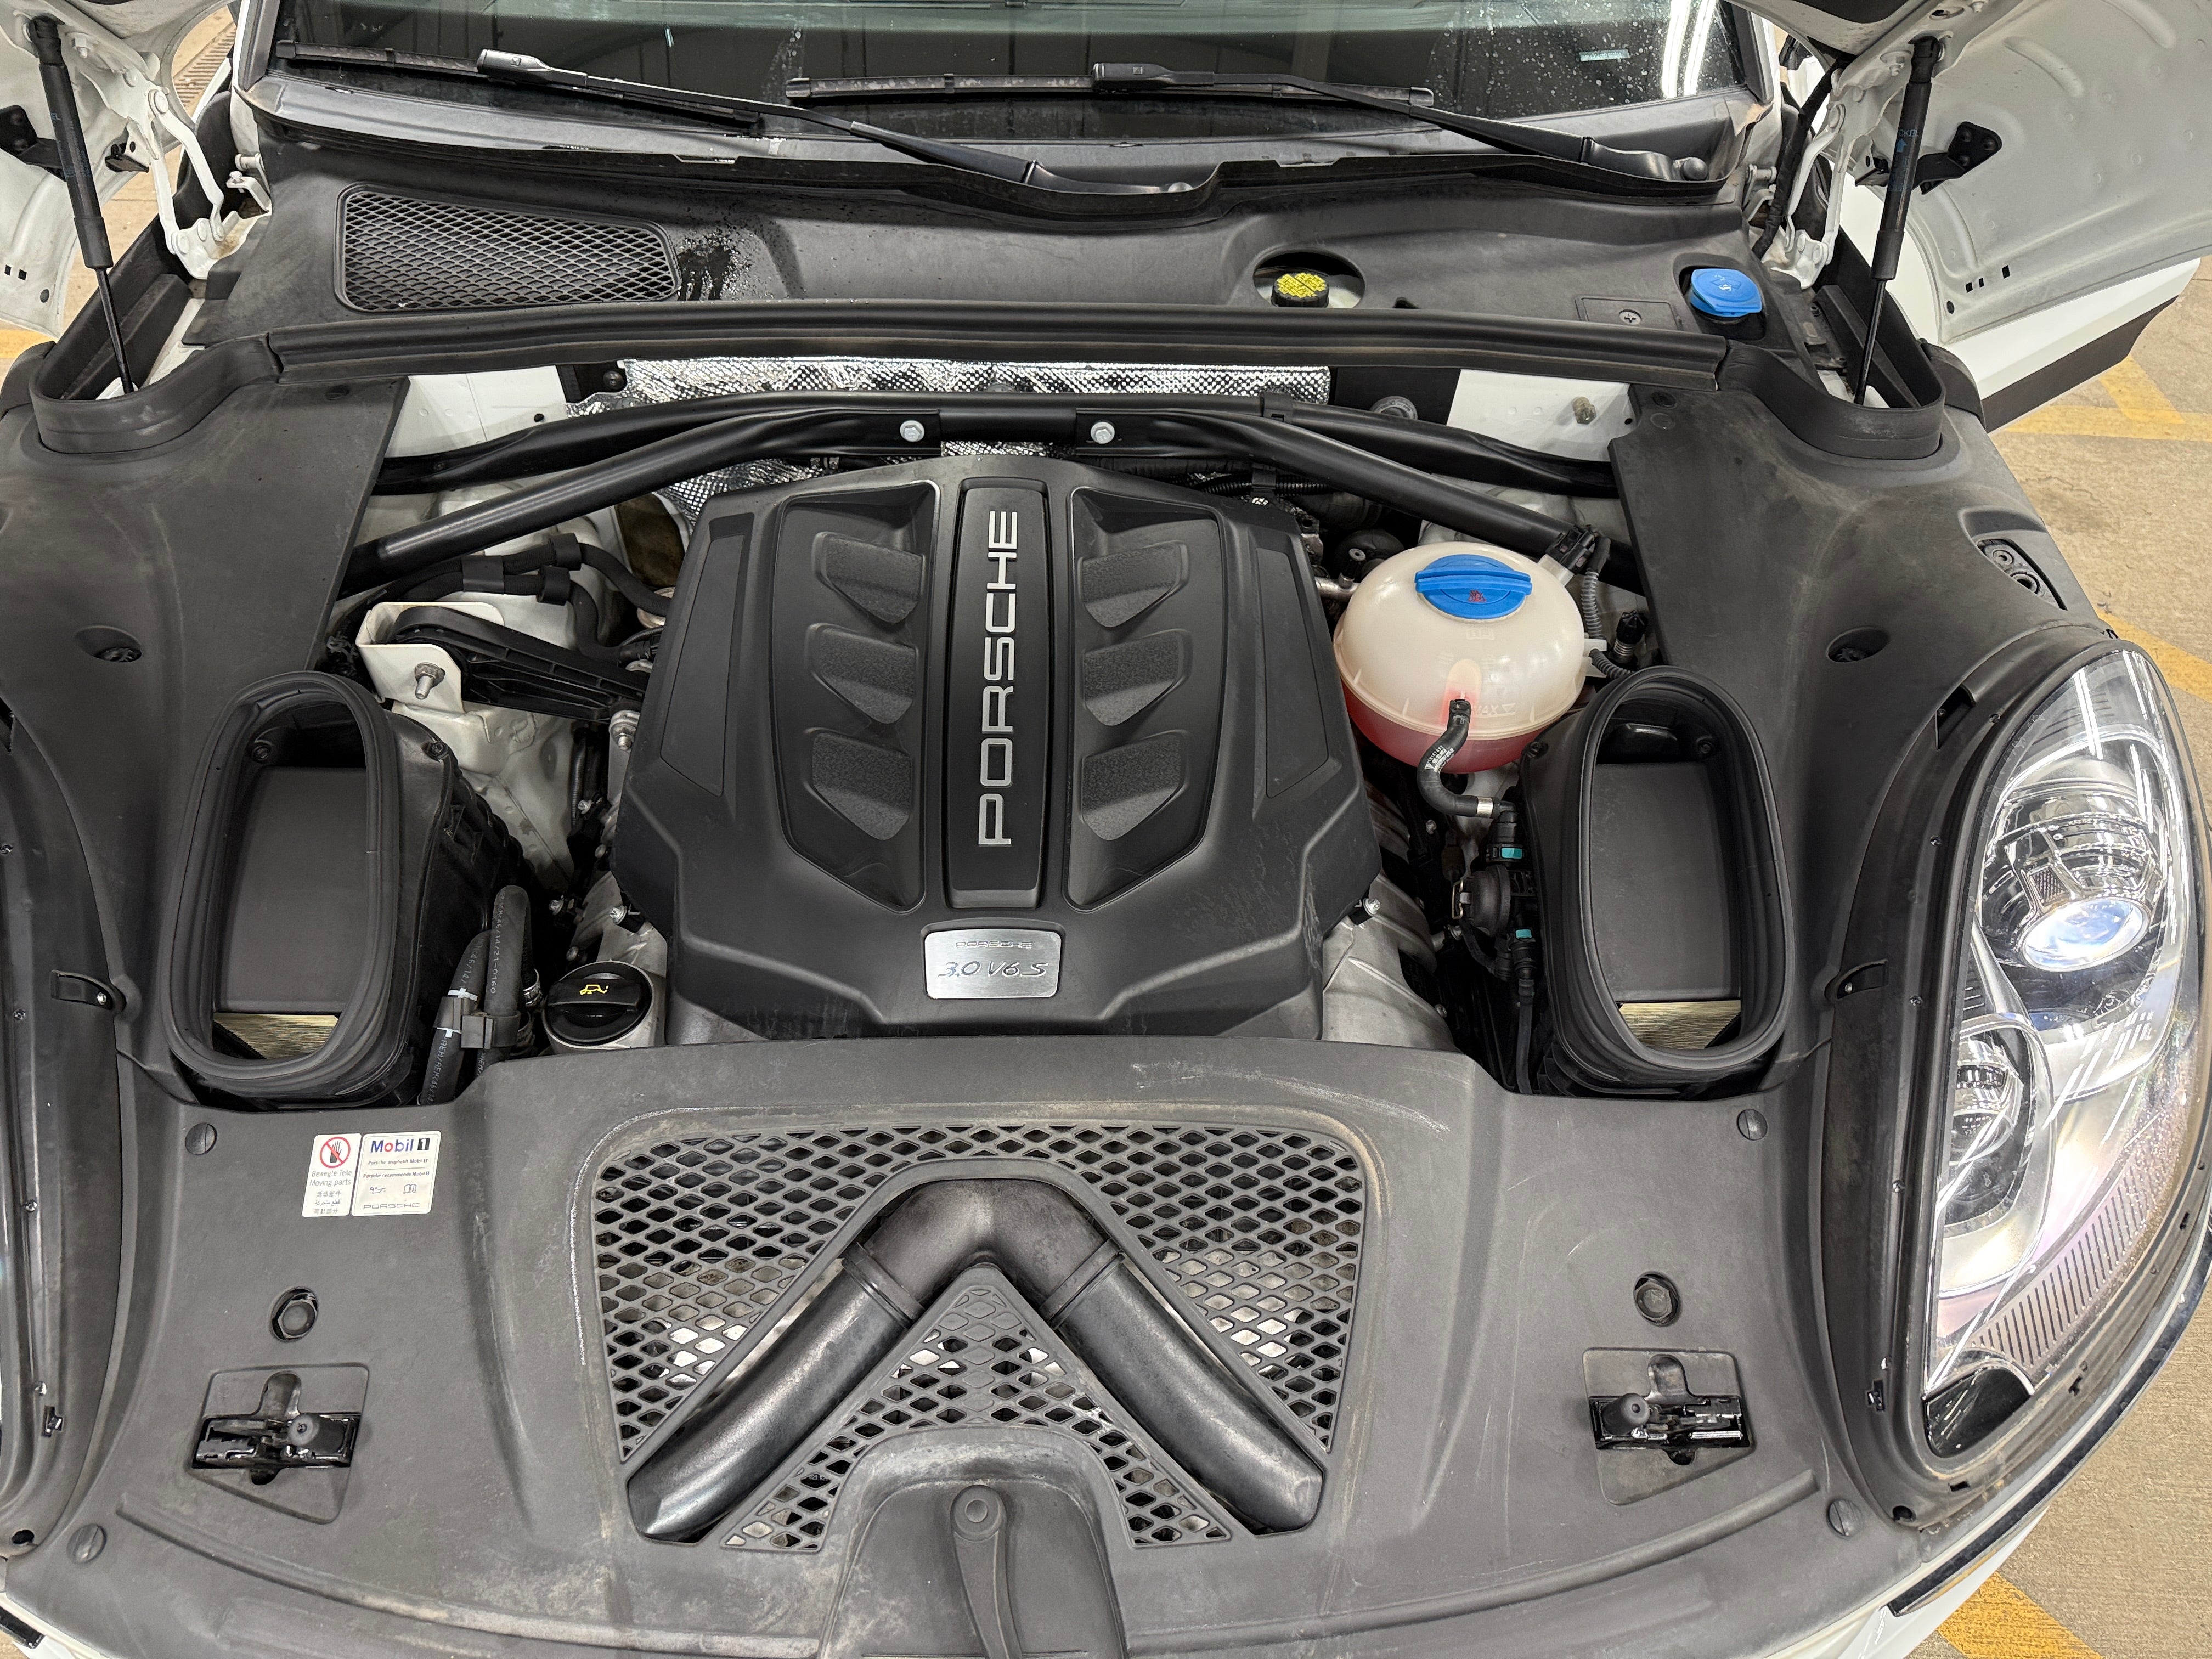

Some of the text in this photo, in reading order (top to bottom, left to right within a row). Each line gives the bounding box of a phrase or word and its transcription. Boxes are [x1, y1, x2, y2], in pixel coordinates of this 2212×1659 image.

[978, 510, 1018, 846] PORSCHE
[955, 940, 1032, 949] PORSCHE
[938, 961, 1049, 977] 3.0 V6 S
[370, 1138, 429, 1153] Mobil 1
[309, 1178, 351, 1187] Moving parts
